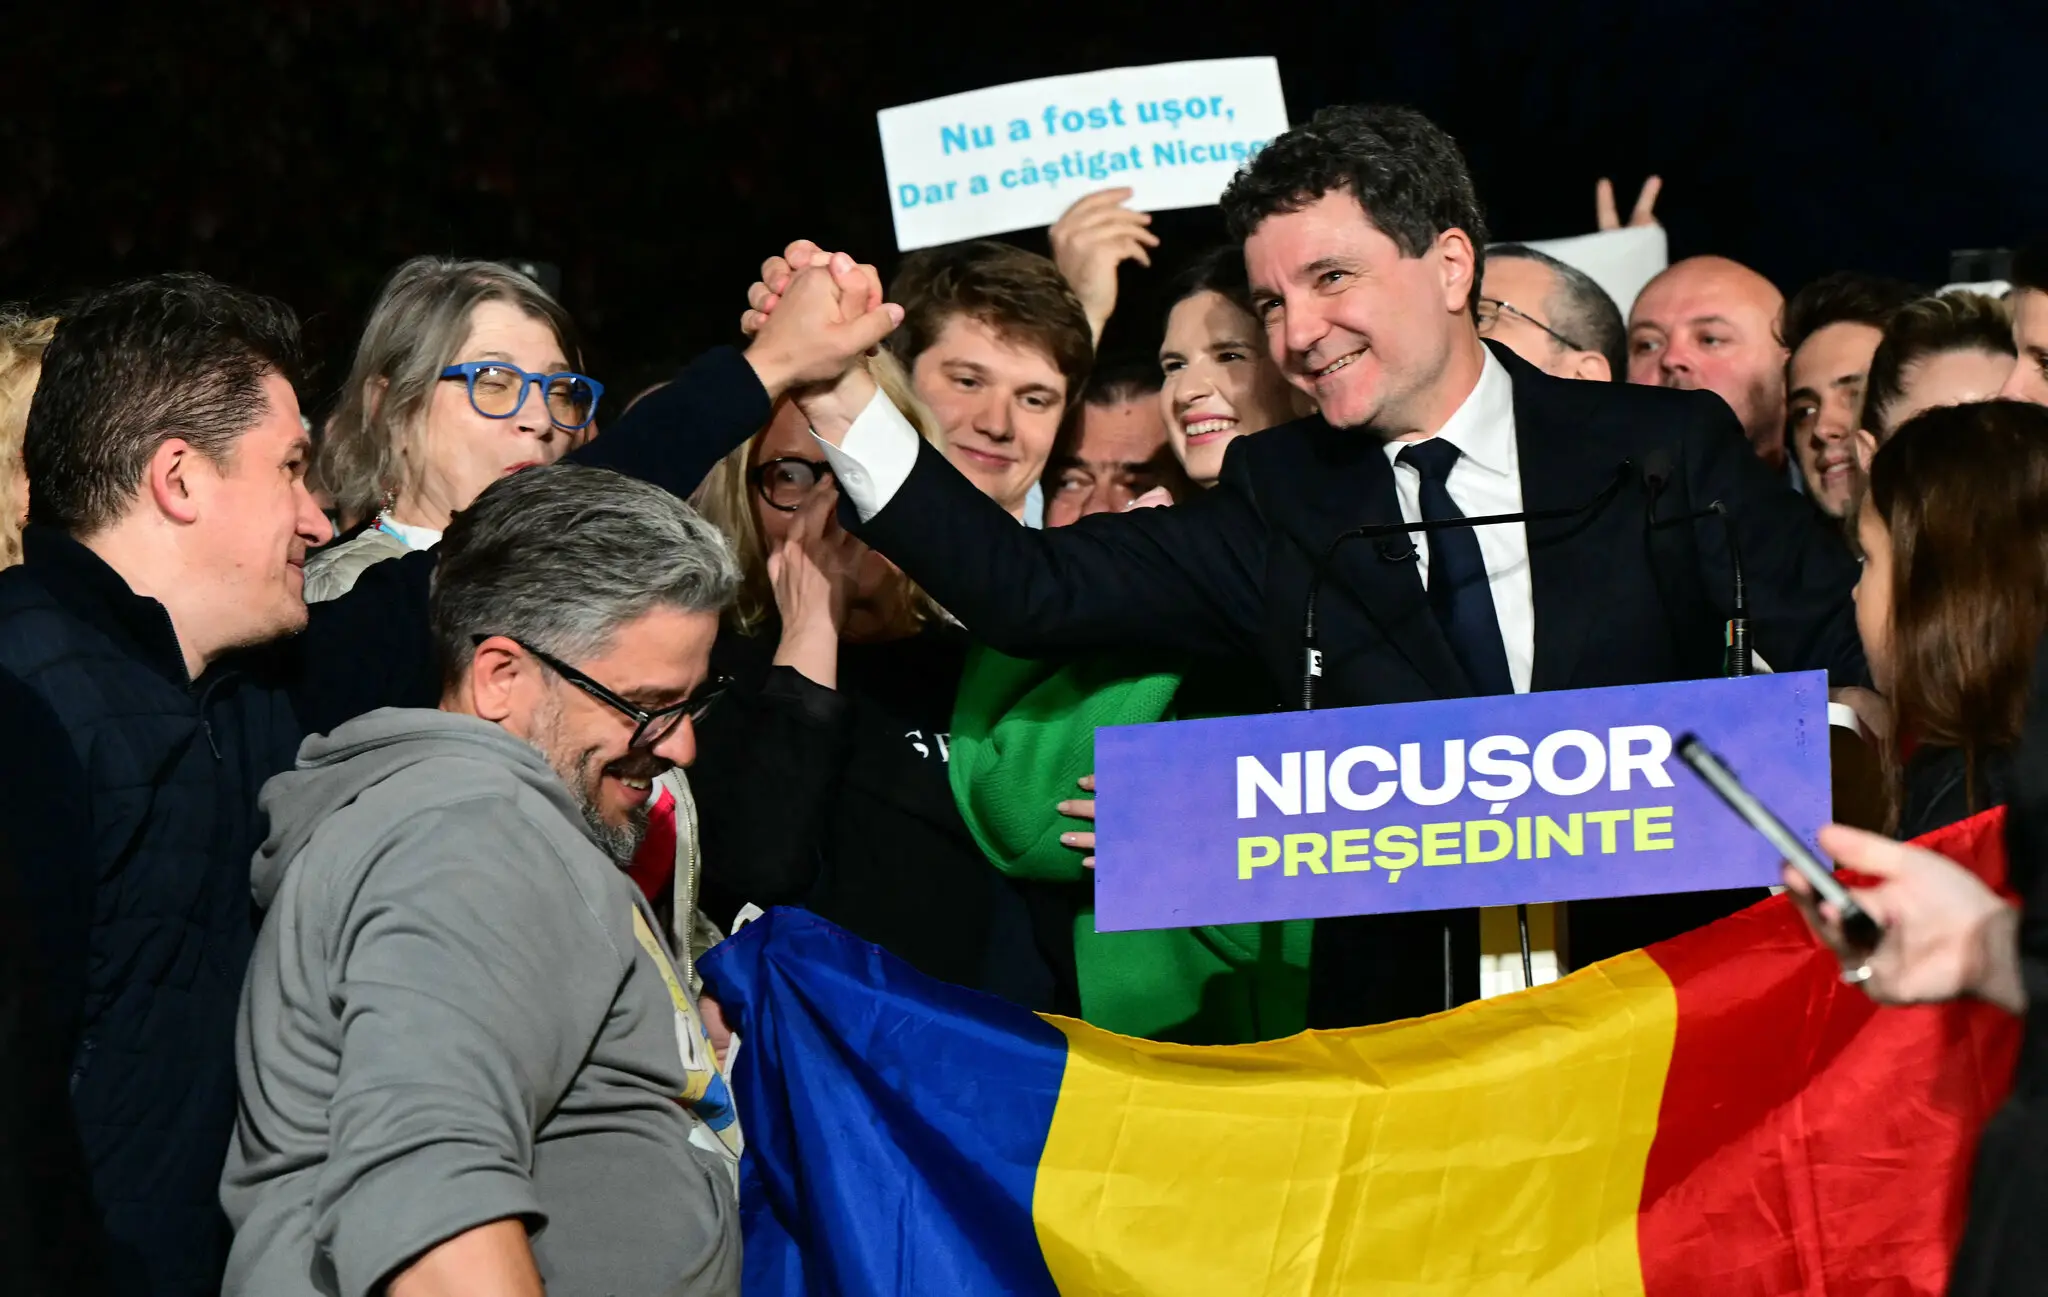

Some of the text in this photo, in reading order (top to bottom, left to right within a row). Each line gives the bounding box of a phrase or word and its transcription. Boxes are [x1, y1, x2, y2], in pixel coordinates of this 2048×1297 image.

[938, 95, 1236, 157] Nu a fost ușor,
[897, 179, 959, 209] Dar
[968, 174, 991, 196] a
[1000, 146, 1144, 189] câștigat
[1235, 723, 1676, 819] NICUȘOR
[1236, 806, 1676, 884] PREȘEDINTE
